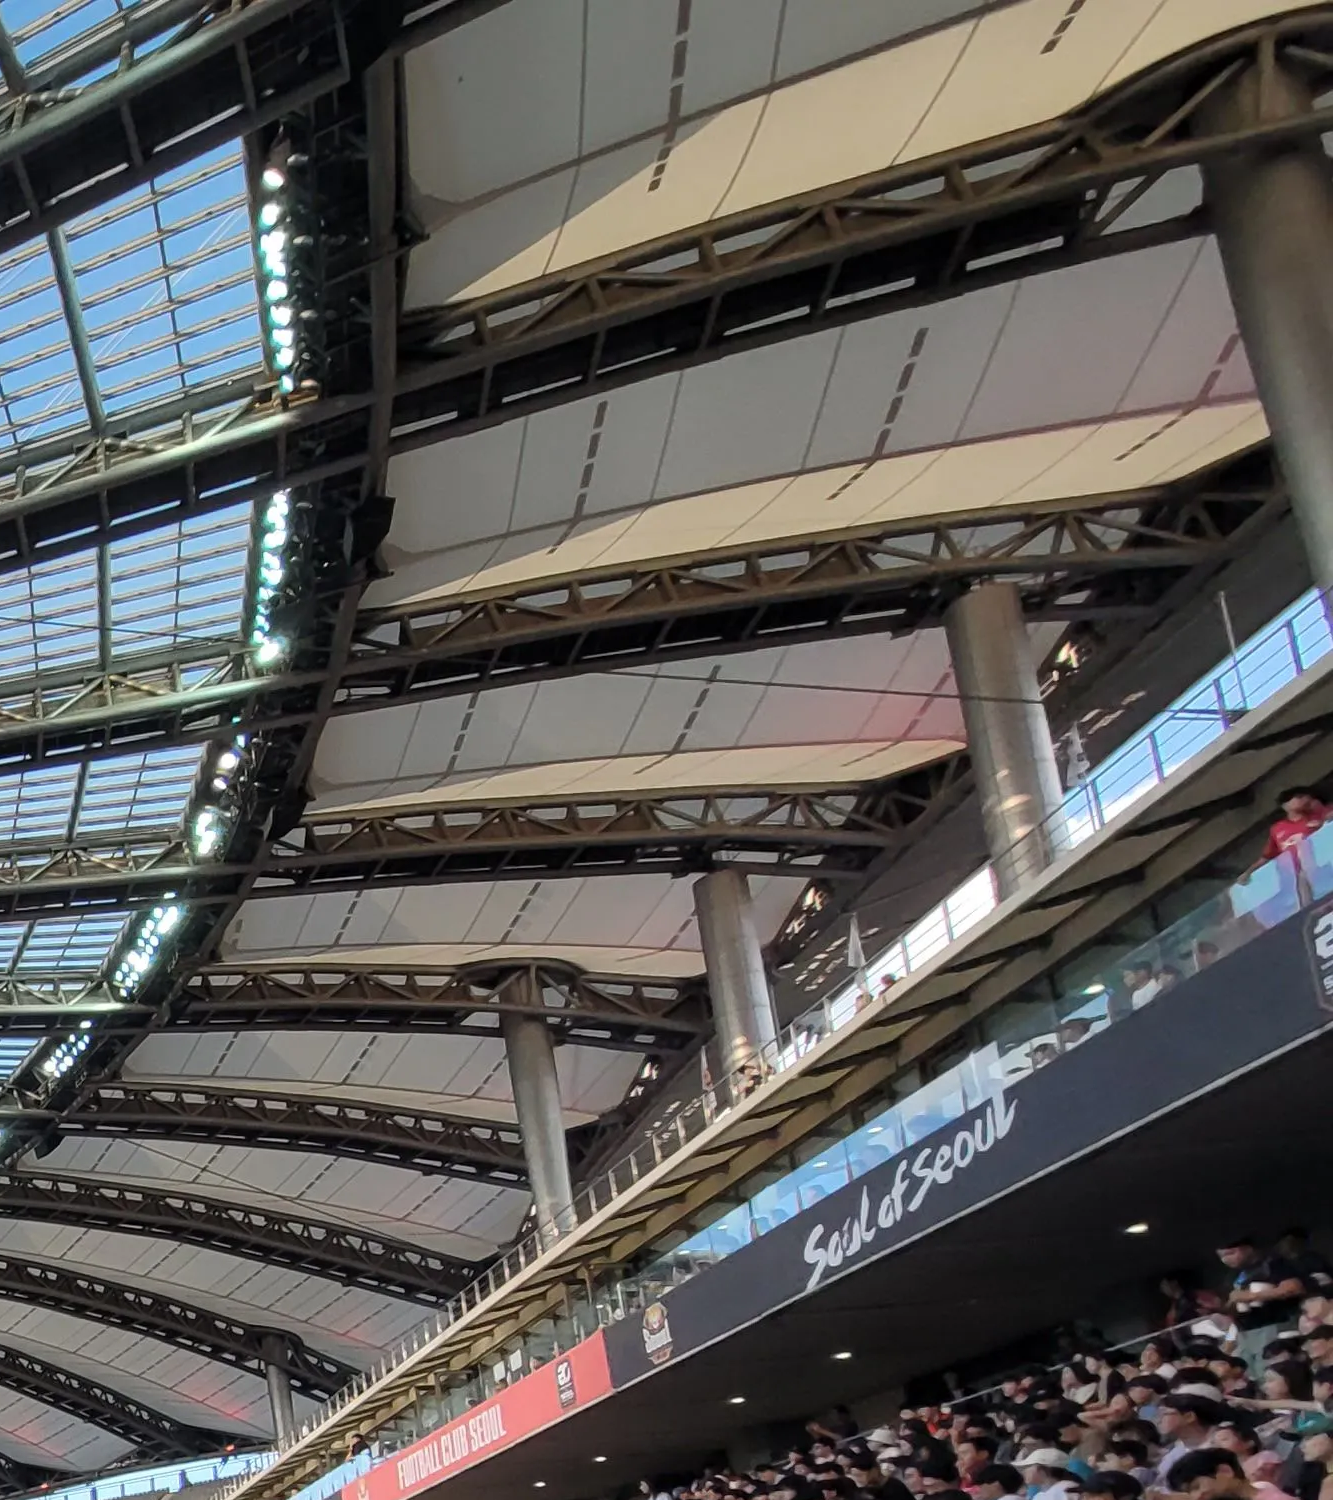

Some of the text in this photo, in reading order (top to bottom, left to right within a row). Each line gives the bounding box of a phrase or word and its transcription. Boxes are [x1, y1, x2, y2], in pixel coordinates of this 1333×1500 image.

[804, 1095, 1018, 1291] Soul of Seoul
[397, 1403, 507, 1491] FOOTBALL CLUB SEOUL
